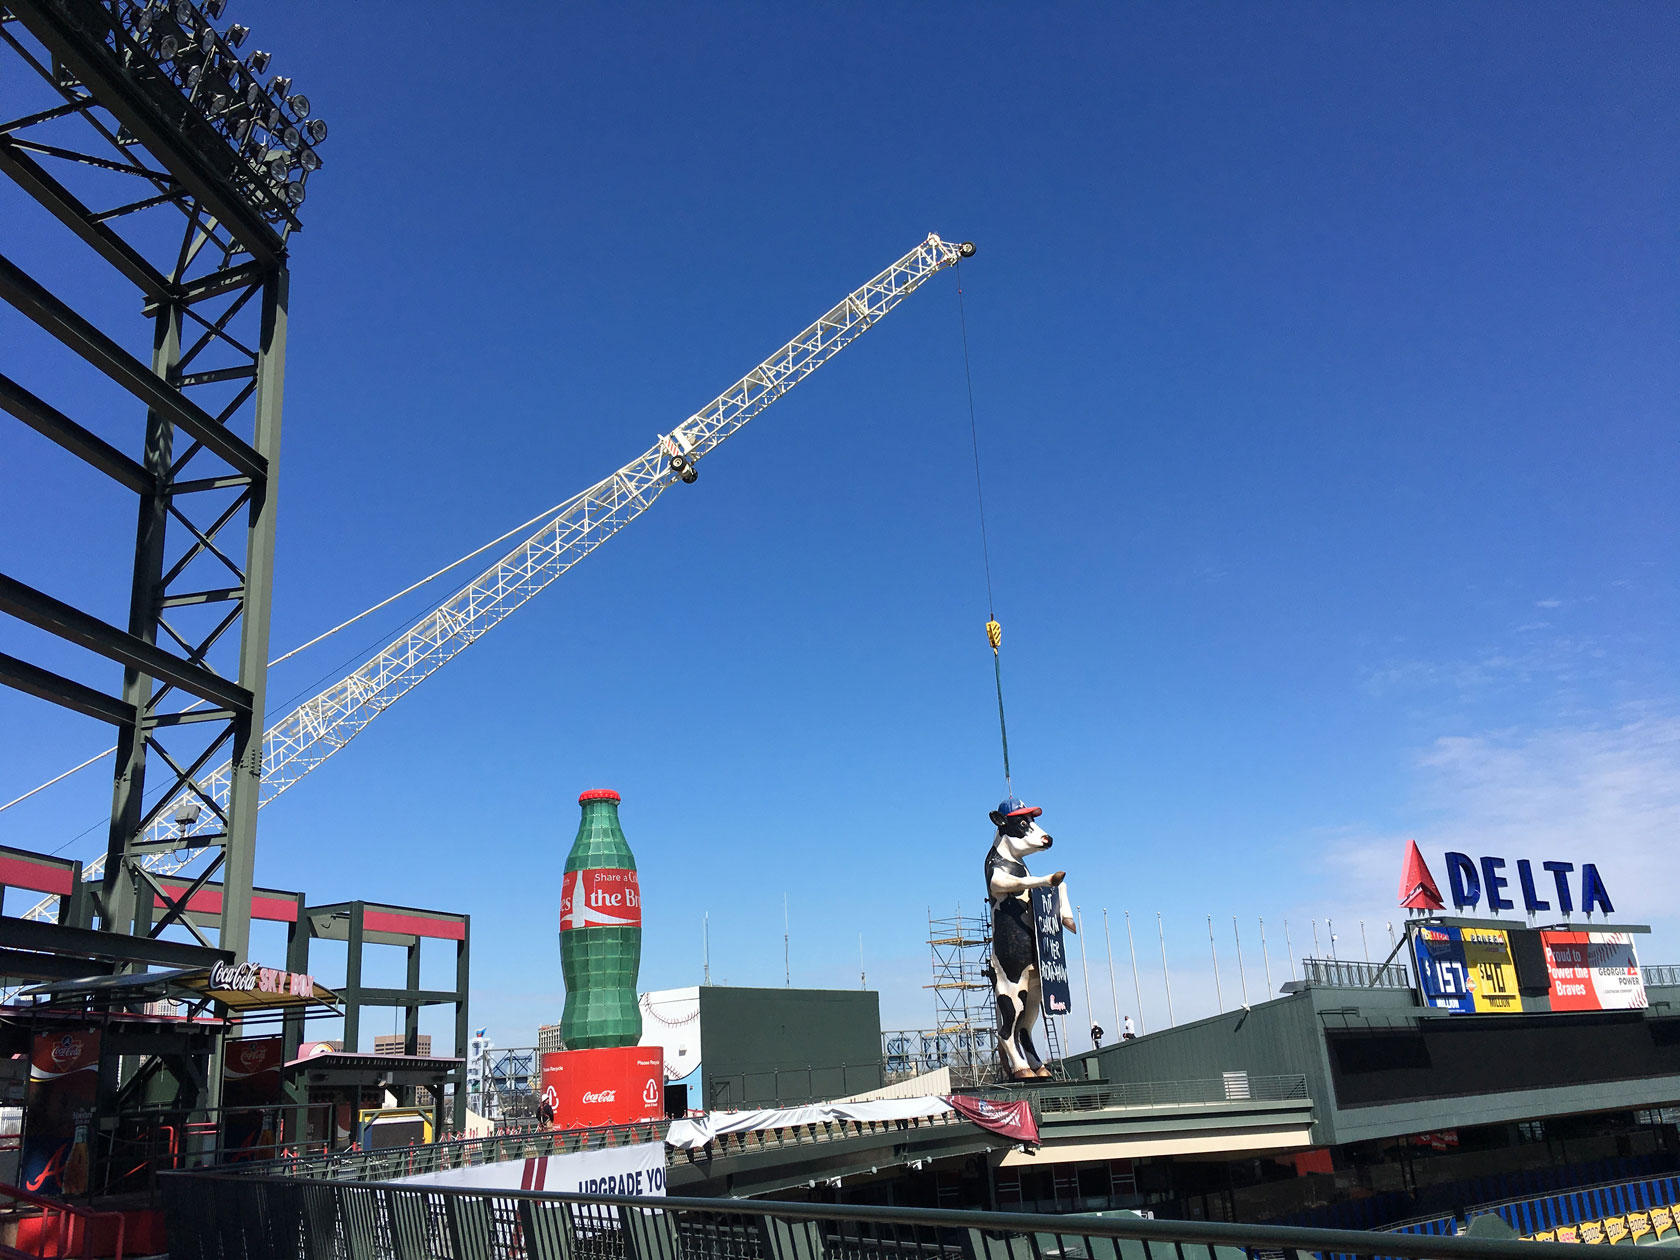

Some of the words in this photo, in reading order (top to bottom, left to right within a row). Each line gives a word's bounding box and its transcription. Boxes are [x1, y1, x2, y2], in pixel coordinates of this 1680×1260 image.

[594, 873, 621, 882] Share
[1445, 852, 1615, 913] DELTA
[590, 889, 622, 907] the
[1545, 947, 1572, 962] Proud
[1572, 949, 1582, 962] to
[208, 960, 260, 991] Coca-Cola
[259, 967, 287, 994] SKY
[289, 972, 315, 998] BOX
[1574, 964, 1589, 979] the
[1598, 967, 1626, 976] GEORGIA
[1555, 980, 1586, 996] Braves
[1618, 977, 1640, 985] POWER
[583, 1090, 616, 1104] Coca-Cola
[578, 1173, 643, 1196] UPGRADE
[1607, 1222, 1623, 1238] 2001
[1629, 1218, 1646, 1233] 2002
[1583, 1226, 1600, 1243] 2000
